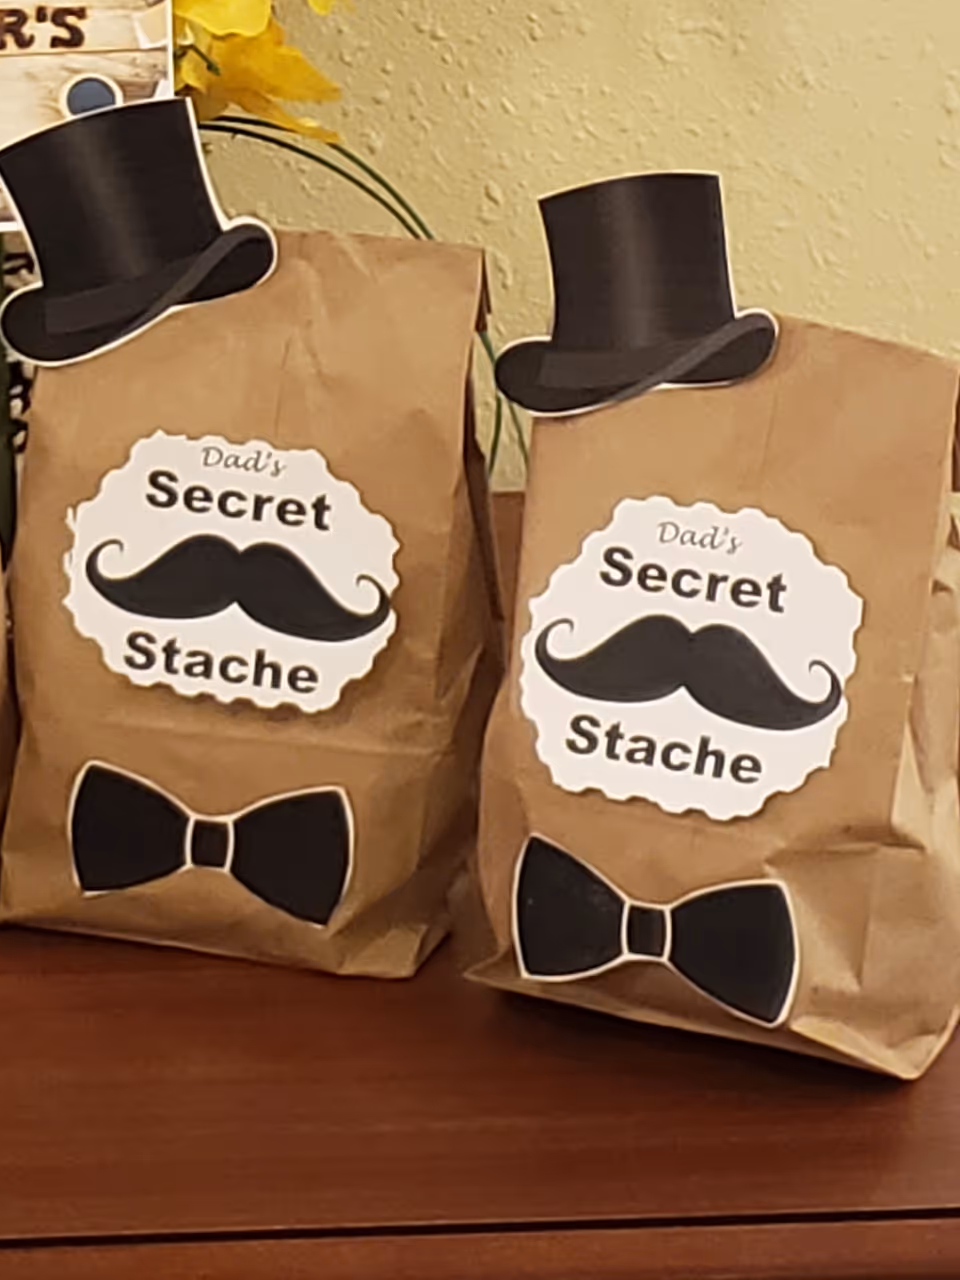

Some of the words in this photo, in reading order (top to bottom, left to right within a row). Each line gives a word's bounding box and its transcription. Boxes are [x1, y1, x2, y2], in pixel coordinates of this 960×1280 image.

[201, 447, 287, 477] Dad's
[146, 470, 331, 531] Secret
[658, 521, 742, 555] Dad's
[599, 547, 787, 613] Secret
[123, 631, 319, 693] Stache
[565, 714, 762, 784] Stache
